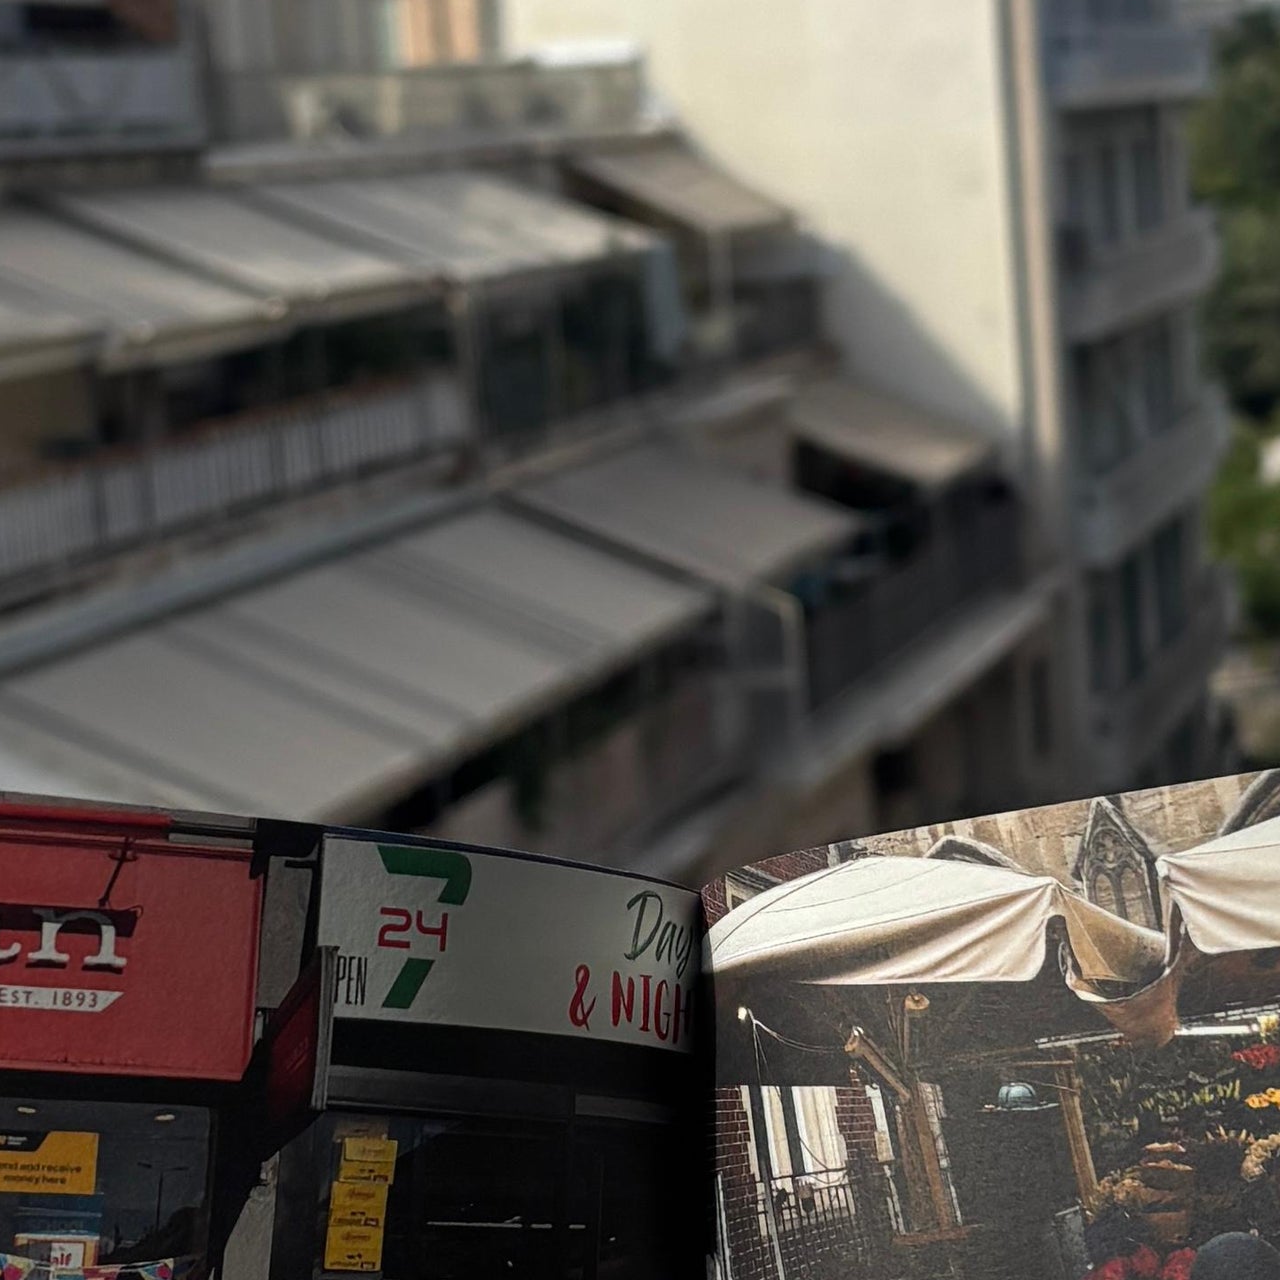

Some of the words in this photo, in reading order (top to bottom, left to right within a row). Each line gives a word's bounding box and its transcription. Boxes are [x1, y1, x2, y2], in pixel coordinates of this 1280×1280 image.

[378, 907, 448, 952] 24
[624, 890, 694, 979] Day
[52, 991, 99, 1009] 1893
[334, 955, 368, 1006] PEN
[569, 964, 597, 1031] &
[612, 971, 693, 1044] NIGH
[3, 1174, 39, 1185] money
[42, 1174, 67, 1184] here
[19, 1163, 40, 1171] and
[41, 1165, 82, 1173] receive
